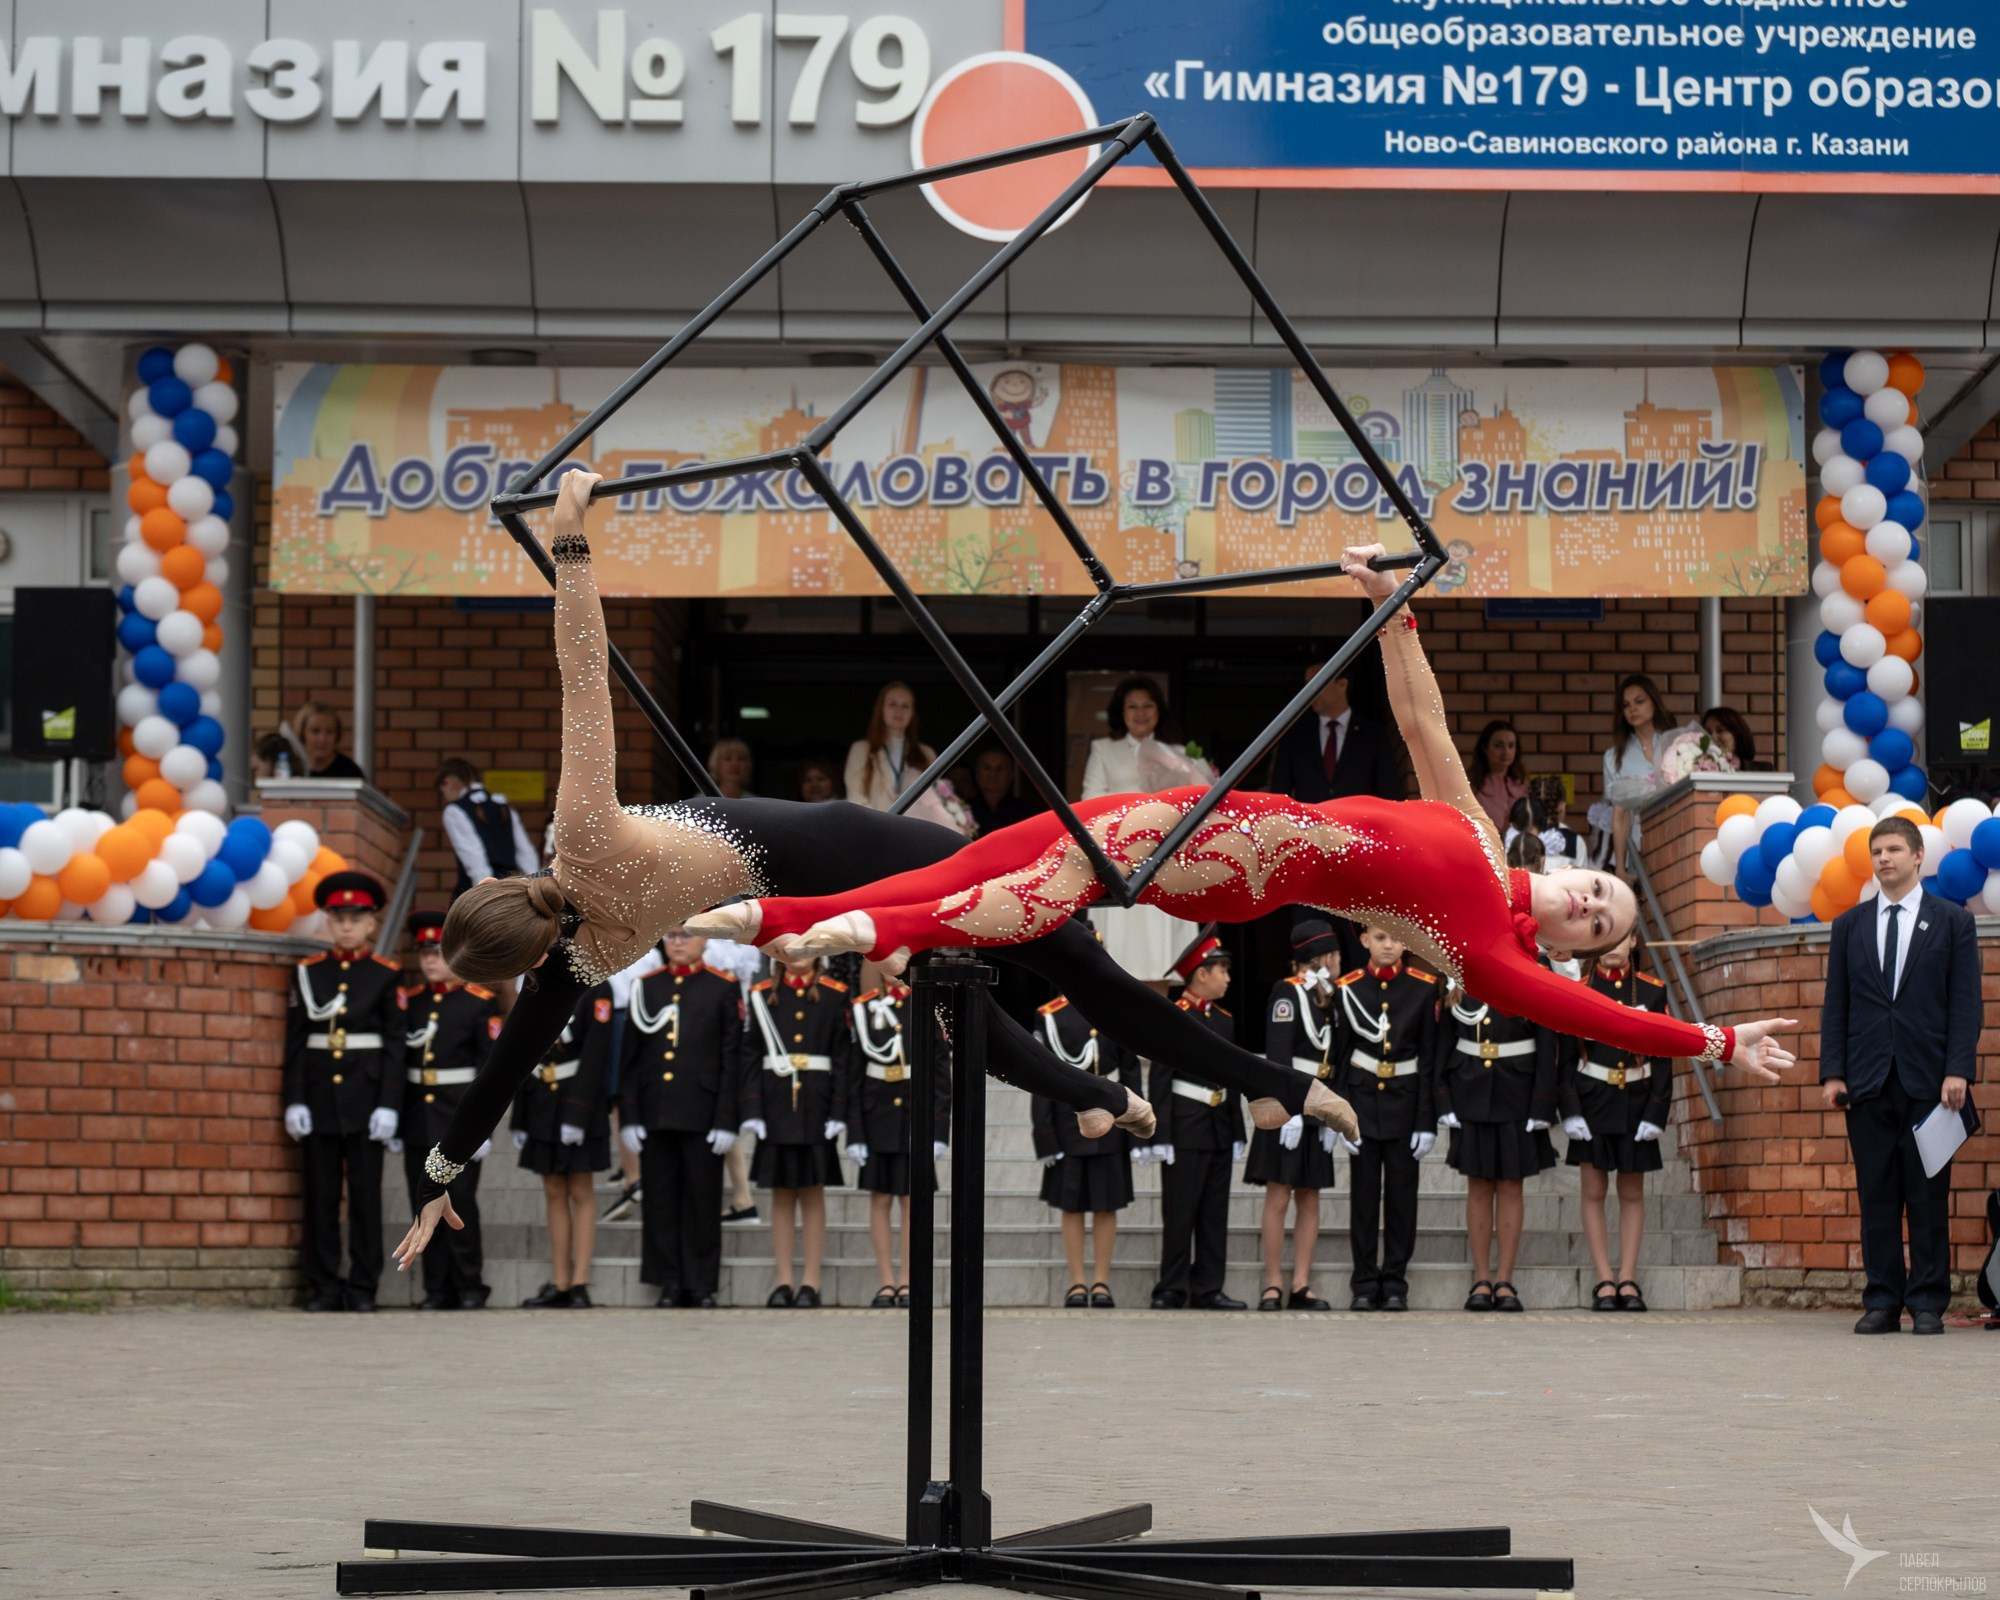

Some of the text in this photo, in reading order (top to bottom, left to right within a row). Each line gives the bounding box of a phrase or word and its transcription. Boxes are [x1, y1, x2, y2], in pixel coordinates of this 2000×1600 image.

[1322, 16, 1977, 54] общеобразовательное учреждение
[1144, 60, 1426, 105] «Гимназия
[1442, 65, 1588, 106] №179
[1635, 67, 1793, 116] Центр
[1808, 66, 2000, 118] образо
[1385, 130, 1910, 160] Ново-Савиновского района г. Казани
[1135, 457, 1174, 503] в
[1198, 459, 1434, 524] город
[1453, 440, 1760, 510] знаний!
